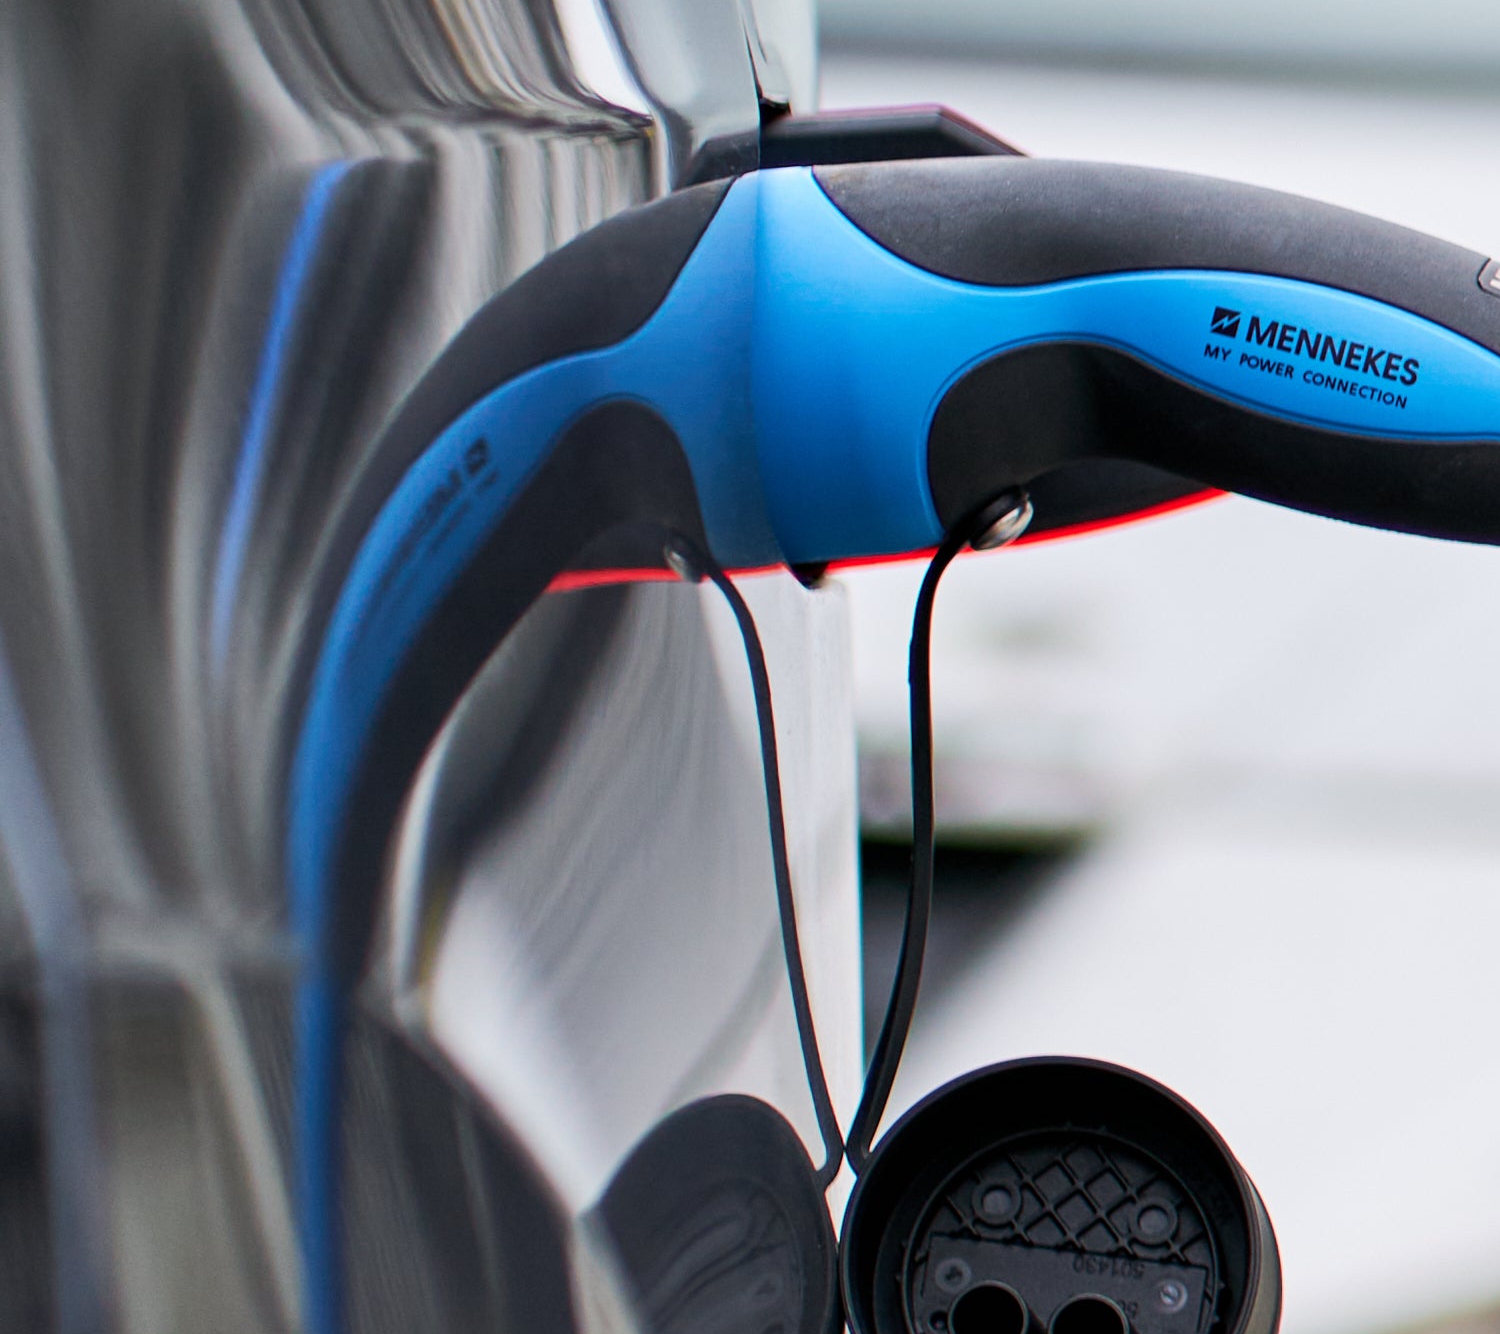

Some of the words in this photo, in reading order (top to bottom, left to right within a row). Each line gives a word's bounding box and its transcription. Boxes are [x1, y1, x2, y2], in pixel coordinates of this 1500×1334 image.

[1204, 344, 1231, 361] MY
[1239, 353, 1294, 379] POWER
[1303, 370, 1408, 409] CONNECTION
[1245, 316, 1420, 386] MENNEKES
